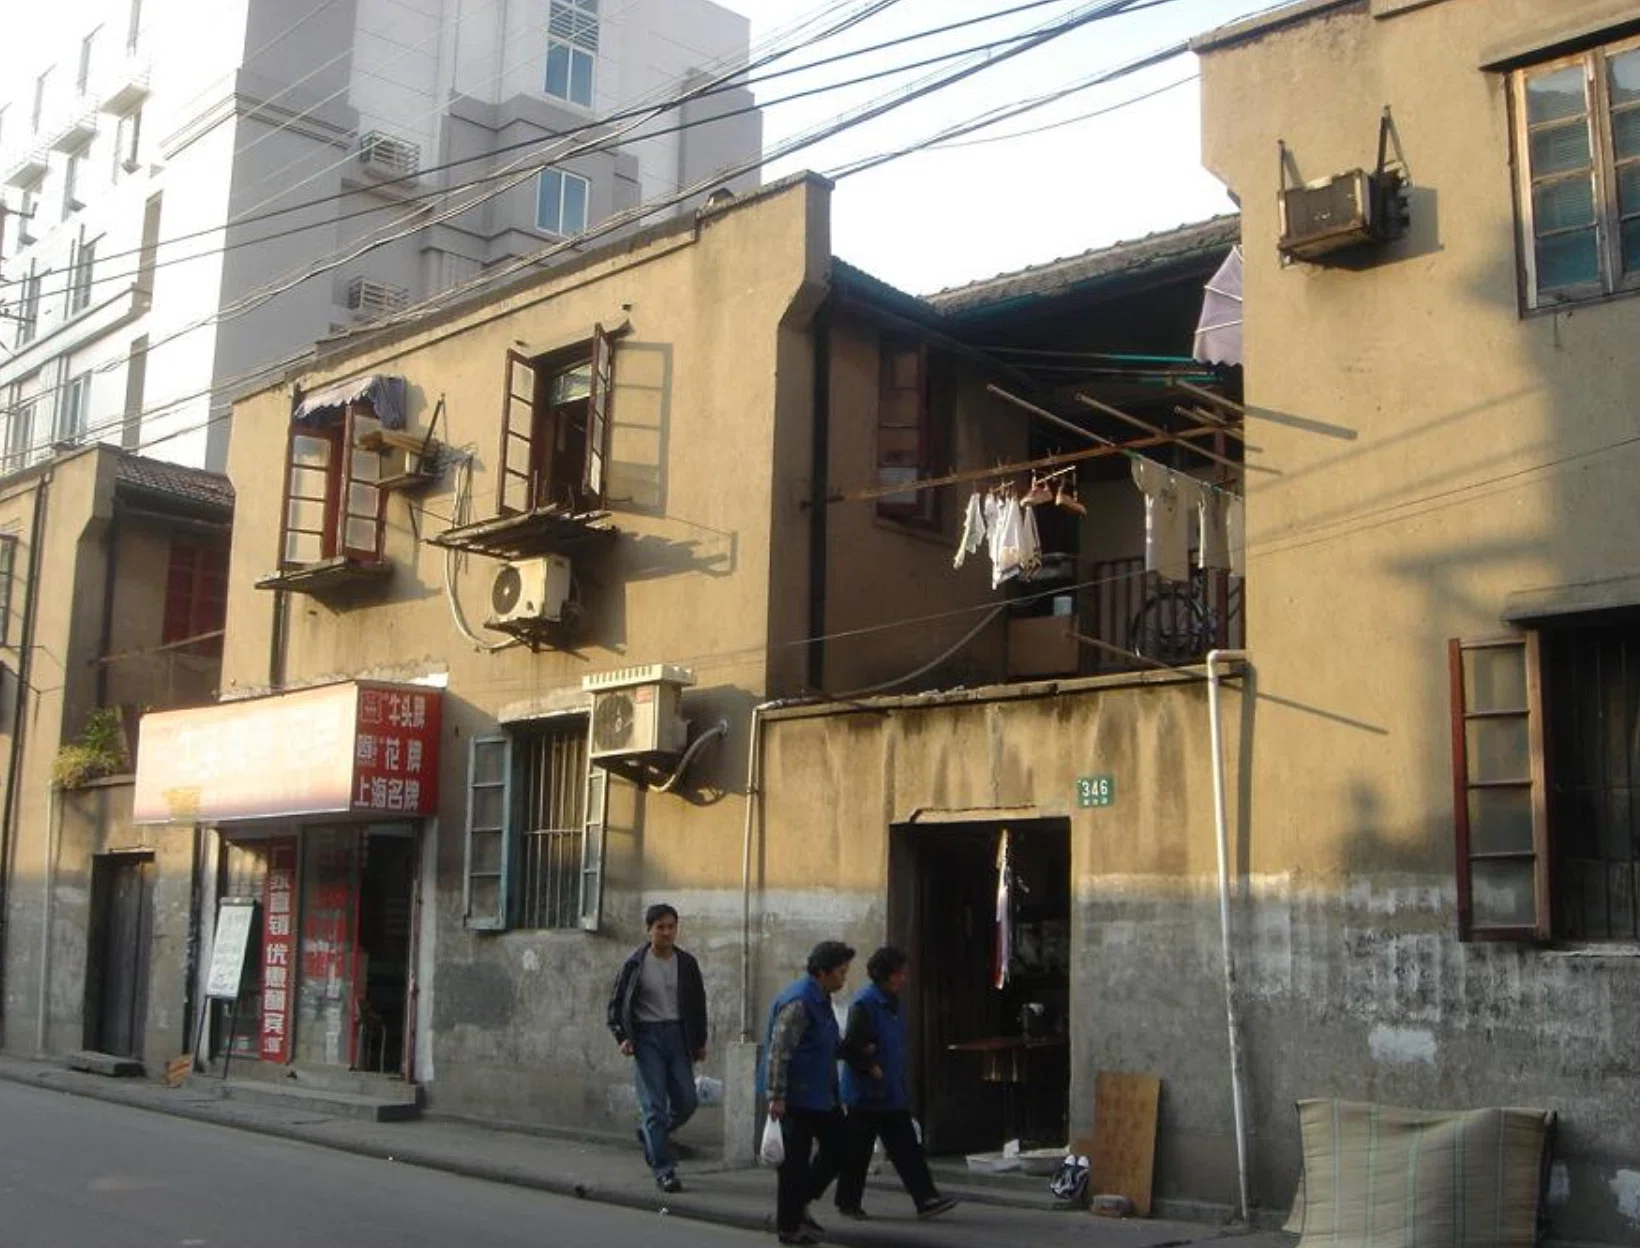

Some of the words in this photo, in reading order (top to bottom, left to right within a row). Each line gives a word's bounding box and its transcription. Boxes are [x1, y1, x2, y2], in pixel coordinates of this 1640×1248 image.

[354, 776, 420, 811] 上海名牌
[1082, 779, 1108, 797] 346
